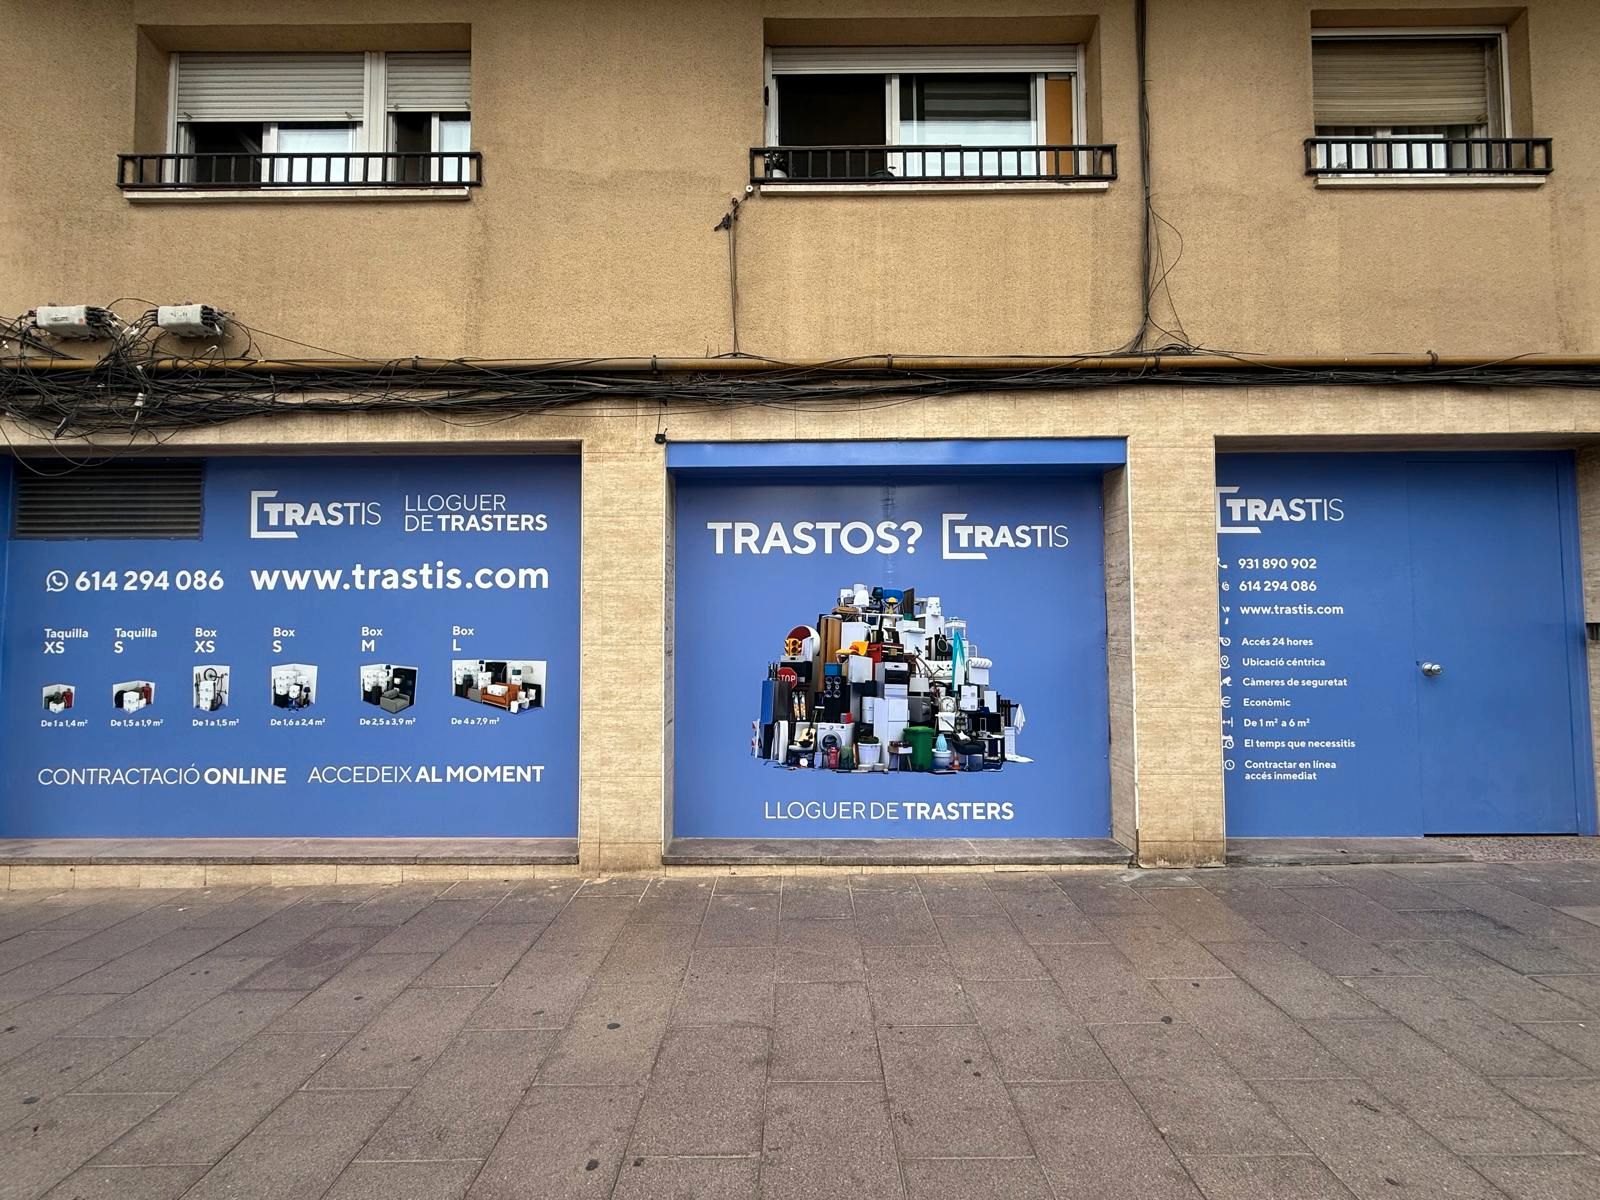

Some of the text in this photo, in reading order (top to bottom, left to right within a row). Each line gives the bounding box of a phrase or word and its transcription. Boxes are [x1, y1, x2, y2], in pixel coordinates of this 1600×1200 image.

[406, 494, 506, 512] LLOGUER
[262, 502, 382, 526] TRASTIS
[1226, 498, 1344, 522] TRASTIS
[404, 514, 548, 532] DE TRASTERS
[708, 520, 922, 554] TRASTOS?
[954, 524, 1069, 548] TRASTIS
[1238, 558, 1316, 570] 931 890 902
[76, 570, 224, 592] 614 294 086
[250, 560, 548, 590] www.trastis.com
[1238, 580, 1316, 592] 614 294 086
[1240, 604, 1344, 614] www.trastis.com
[44, 626, 88, 641] Taquilla
[114, 626, 158, 641] Taquilla
[196, 628, 216, 638] Box
[274, 628, 294, 636] Box
[362, 626, 382, 636] Box
[452, 626, 474, 636] Box
[44, 642, 64, 654] XS
[114, 640, 124, 654] S
[194, 640, 216, 652] XS
[272, 640, 282, 652] S
[362, 640, 374, 652] M
[452, 638, 462, 652] L
[1242, 638, 1314, 646] Accés 24 hores
[1242, 658, 1326, 666] Ubicació céntrica
[1242, 678, 1348, 688] Càmeres de seguretat
[1244, 698, 1290, 706] Econòmic
[1244, 718, 1258, 726] De
[1288, 718, 1296, 728] 6
[1244, 738, 1356, 750] El temps que necessitis
[1244, 760, 1298, 768] Contractar
[1312, 760, 1336, 768] línea
[38, 762, 286, 786] CONTRACTACIÓ ONLINE
[308, 766, 544, 784] ACCEDEIX AL MOMENT
[1244, 772, 1316, 780] accés inmediat
[766, 802, 1014, 820] LLOGUER DE TRASTERS
